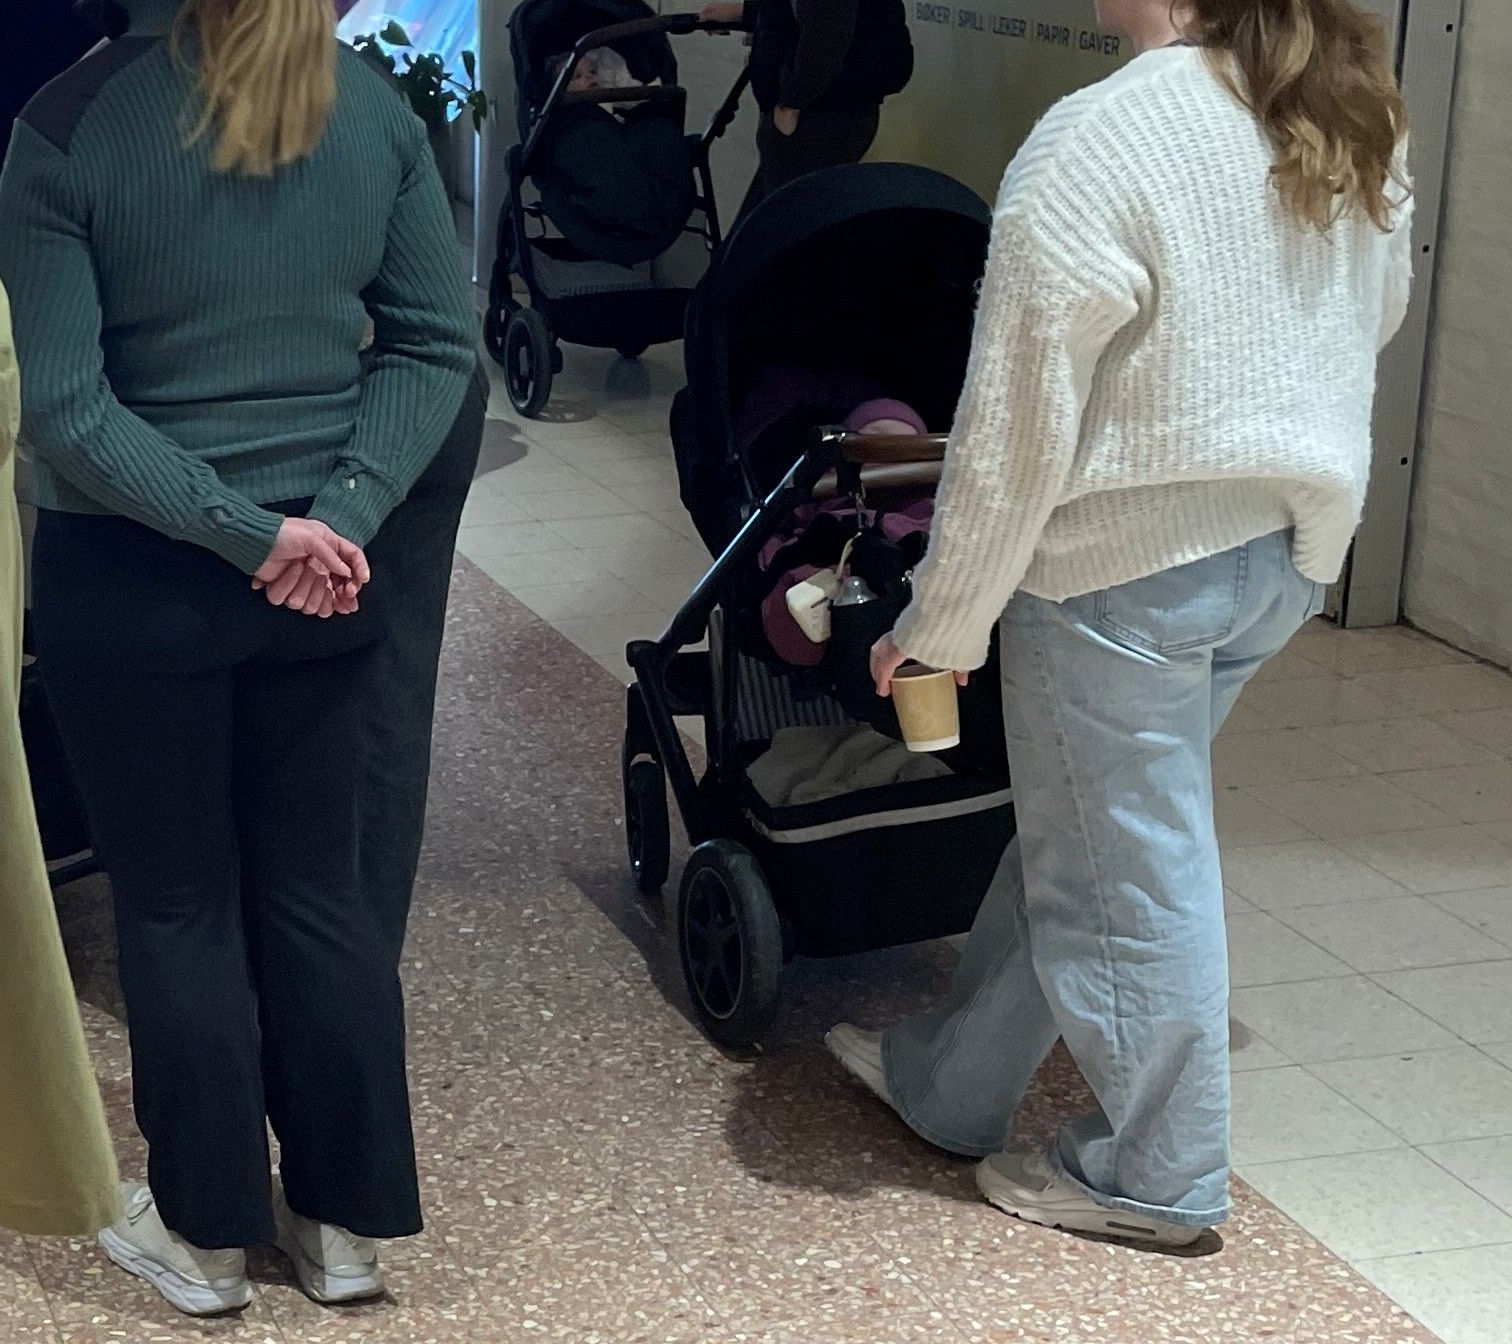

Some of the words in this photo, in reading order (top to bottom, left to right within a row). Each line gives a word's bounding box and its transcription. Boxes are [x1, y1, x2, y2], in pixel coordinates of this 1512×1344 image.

[958, 8, 985, 32] SPILL
[992, 16, 1027, 39] LEKER
[1037, 22, 1071, 47] PAPIR
[1079, 29, 1120, 56] GAVER
